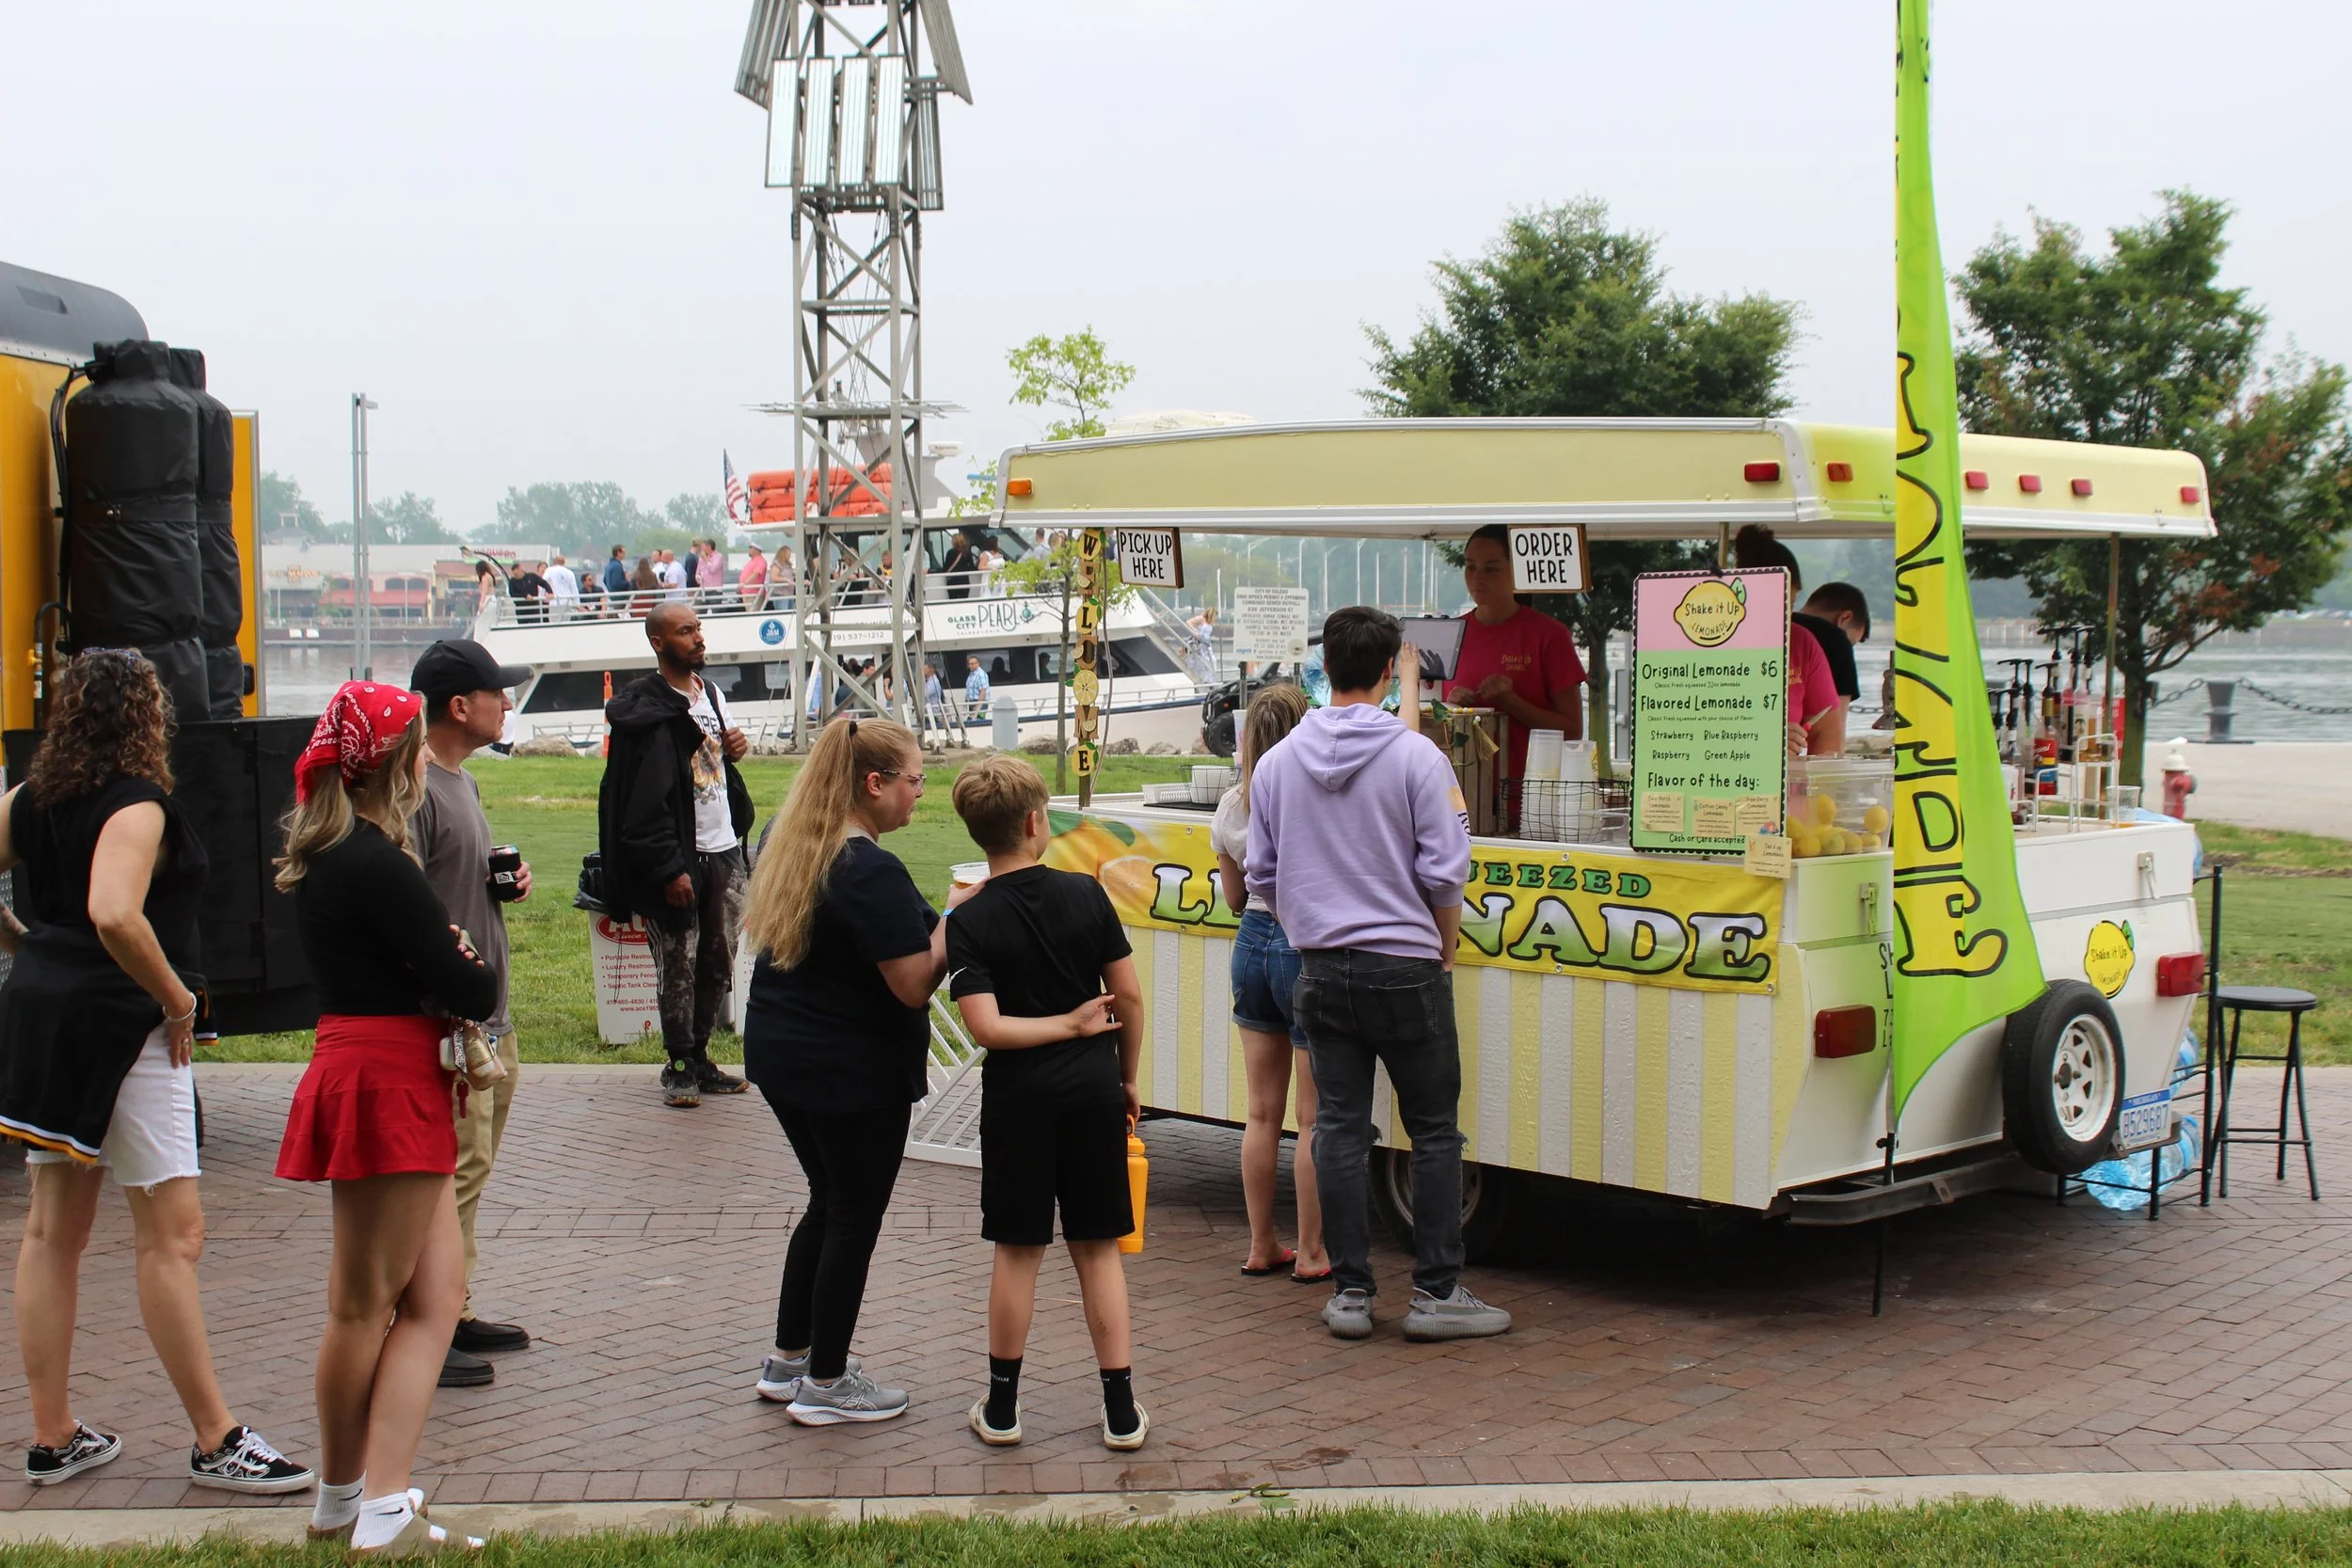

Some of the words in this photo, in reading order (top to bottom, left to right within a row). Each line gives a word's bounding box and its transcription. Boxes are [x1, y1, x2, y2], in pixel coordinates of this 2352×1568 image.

[1120, 531, 1151, 555] PICK
[1154, 533, 1172, 557] UP
[1515, 531, 1573, 557] ORDER
[1132, 556, 1165, 579] HERE
[1526, 559, 1567, 584] HERE
[977, 602, 1021, 632] PEARL
[1685, 603, 1713, 617] Shake
[1716, 602, 1724, 612] it
[1727, 601, 1740, 616] Up
[947, 615, 977, 624] GLASS
[1692, 621, 1728, 636] LEMONADE
[1642, 663, 1689, 679] Original
[1692, 662, 1750, 679] Lemonade
[1761, 660, 1778, 677] $6
[1641, 695, 1691, 711] Flavored
[1695, 695, 1752, 711] Lemonade
[1763, 694, 1778, 710] $7
[1651, 730, 1693, 741] Strawberry
[1704, 730, 1720, 741] Blue
[1722, 730, 1759, 741] Raspberry
[1652, 750, 1690, 761] Raspberry
[1705, 750, 1727, 760] Green
[1729, 751, 1751, 761] Apple
[1647, 771, 1685, 788] Flavor
[1690, 773, 1705, 787] of
[1708, 773, 1730, 787] the
[1735, 774, 1760, 790] day:
[1669, 833, 1686, 843] Cash
[1714, 835, 1745, 845] accepted
[2090, 948, 2110, 963] Shake
[2111, 947, 2118, 959] it
[2120, 944, 2128, 959] Up
